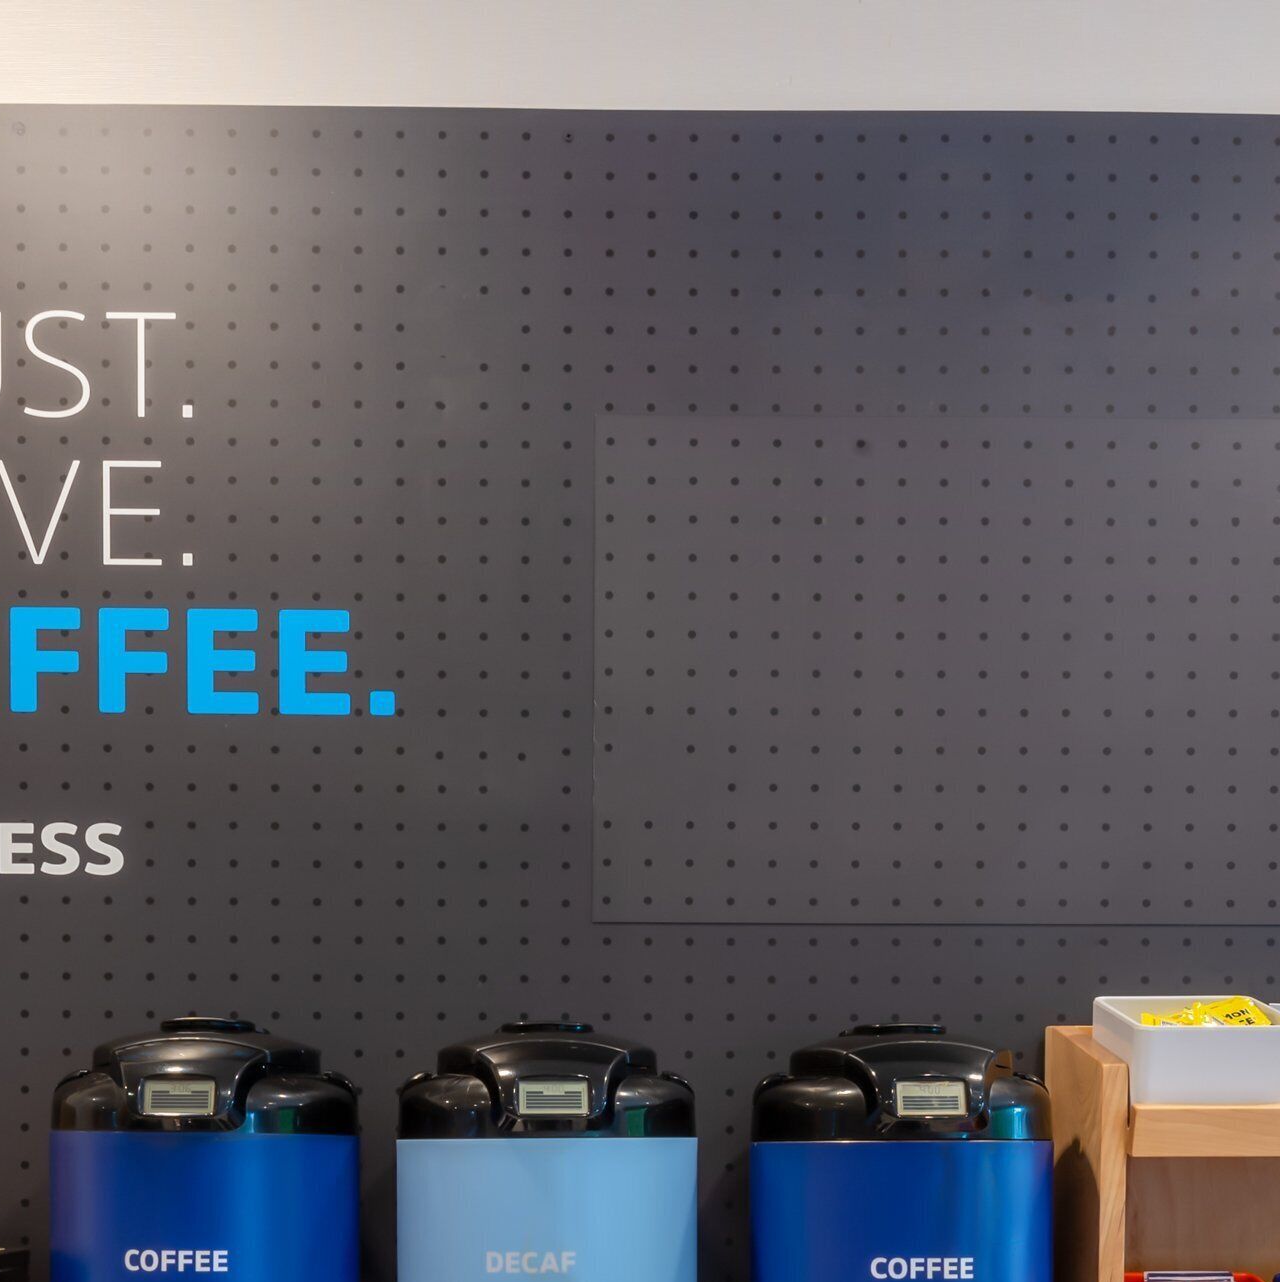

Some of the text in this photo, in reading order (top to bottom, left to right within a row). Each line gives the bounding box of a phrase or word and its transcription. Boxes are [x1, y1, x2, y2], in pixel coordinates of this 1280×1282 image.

[124, 1249, 228, 1272] COFFEE
[486, 1251, 576, 1273] DECAF
[870, 1257, 974, 1279] COFFEE
